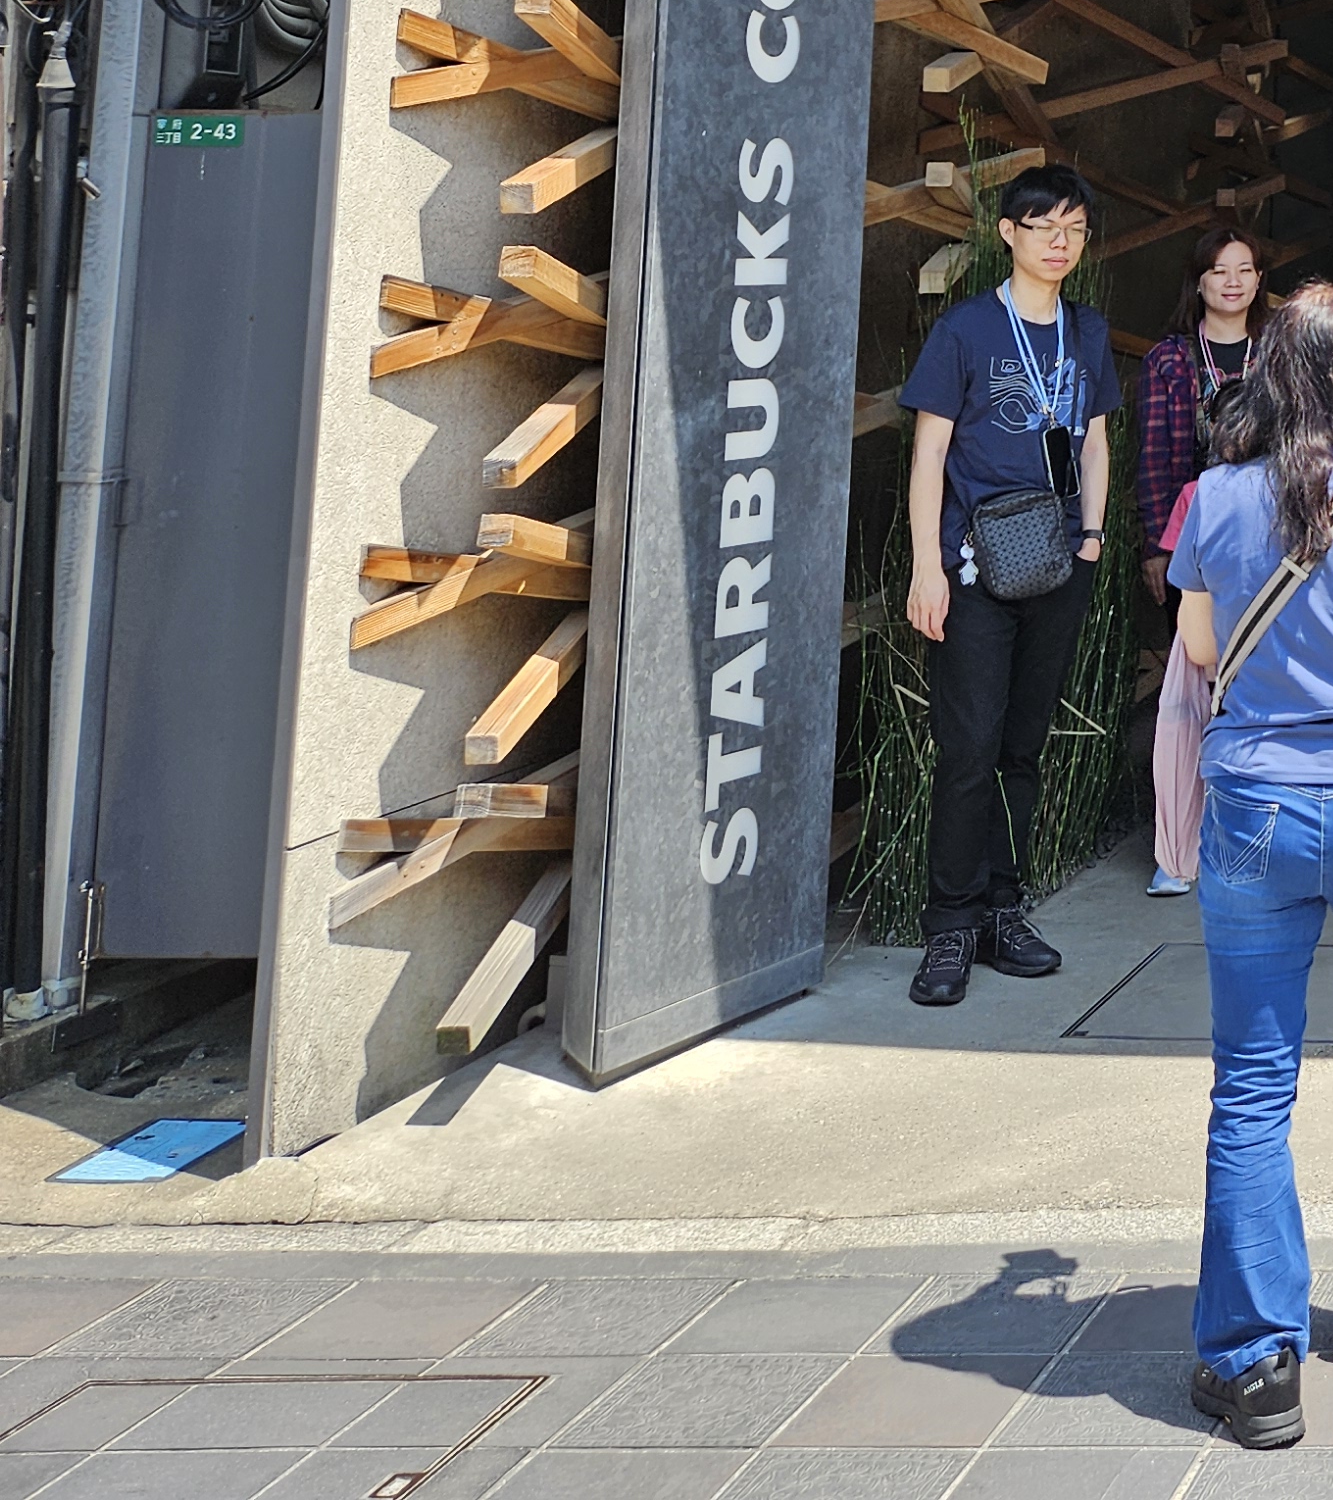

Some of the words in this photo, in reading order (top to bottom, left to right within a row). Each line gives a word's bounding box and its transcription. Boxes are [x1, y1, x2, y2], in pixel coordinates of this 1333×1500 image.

[155, 132, 182, 144] 三丁目
[190, 123, 236, 140] 2-43
[700, 137, 794, 885] STARBUCKS
[1243, 1377, 1264, 1395] AIGLE
